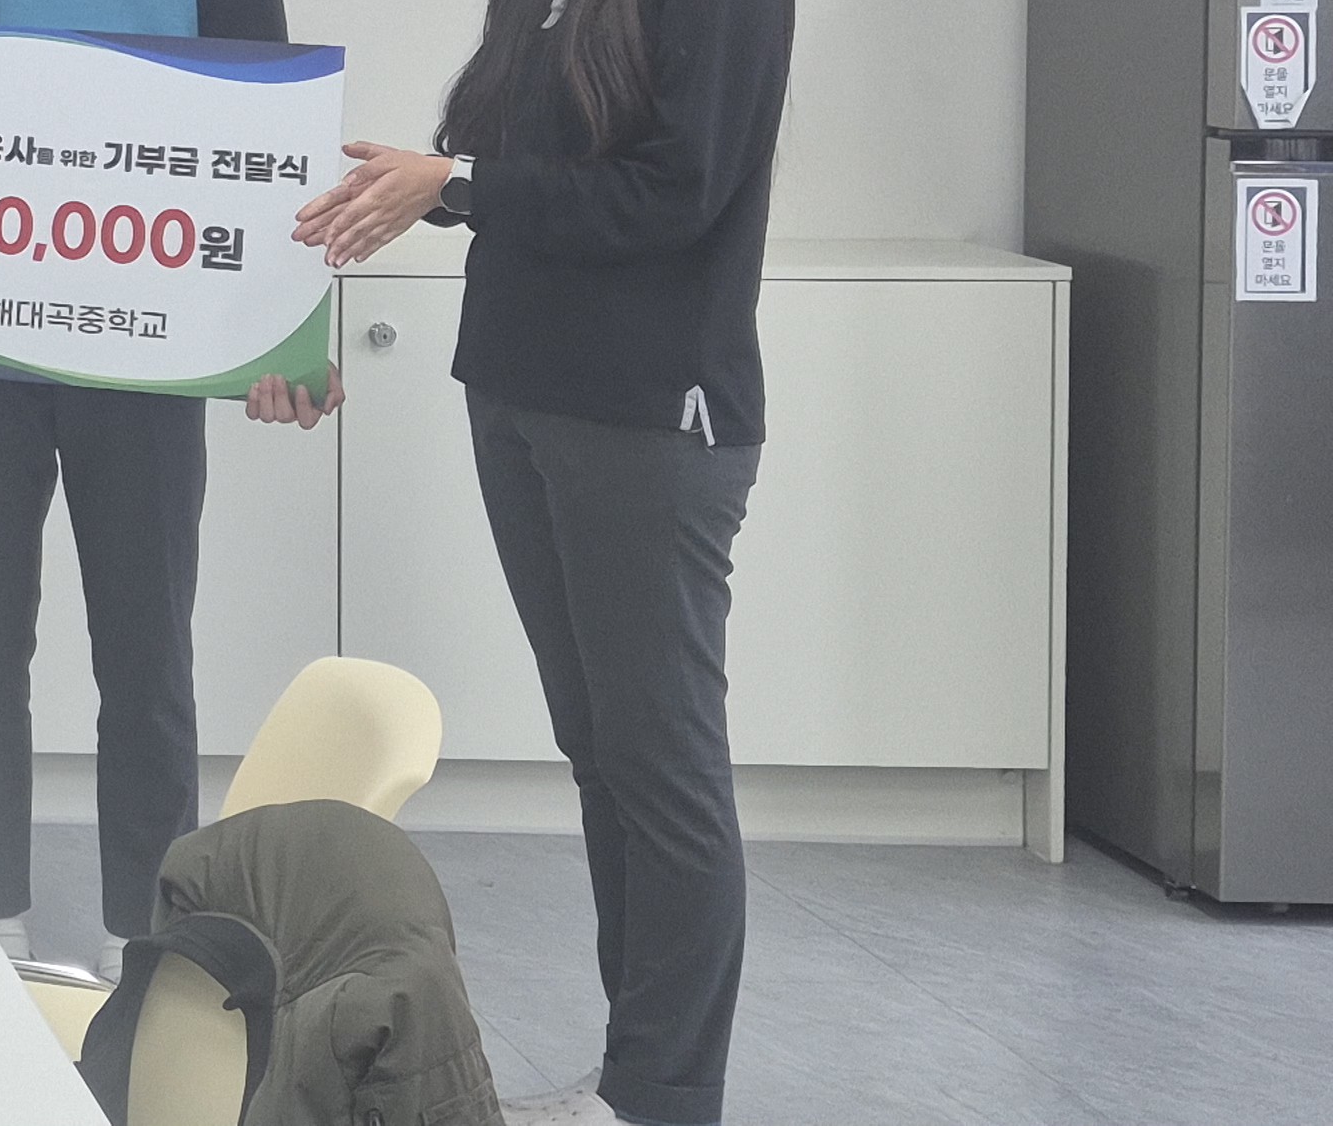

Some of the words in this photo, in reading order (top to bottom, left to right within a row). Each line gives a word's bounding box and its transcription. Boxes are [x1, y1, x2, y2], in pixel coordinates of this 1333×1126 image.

[1263, 84, 1288, 99] 열지
[59, 148, 98, 169] 위한
[102, 140, 200, 178] 기부금
[211, 147, 310, 186] 전달식
[1261, 239, 1287, 254] 문을
[1261, 255, 1286, 270] 열지
[1255, 273, 1292, 287] 마세요
